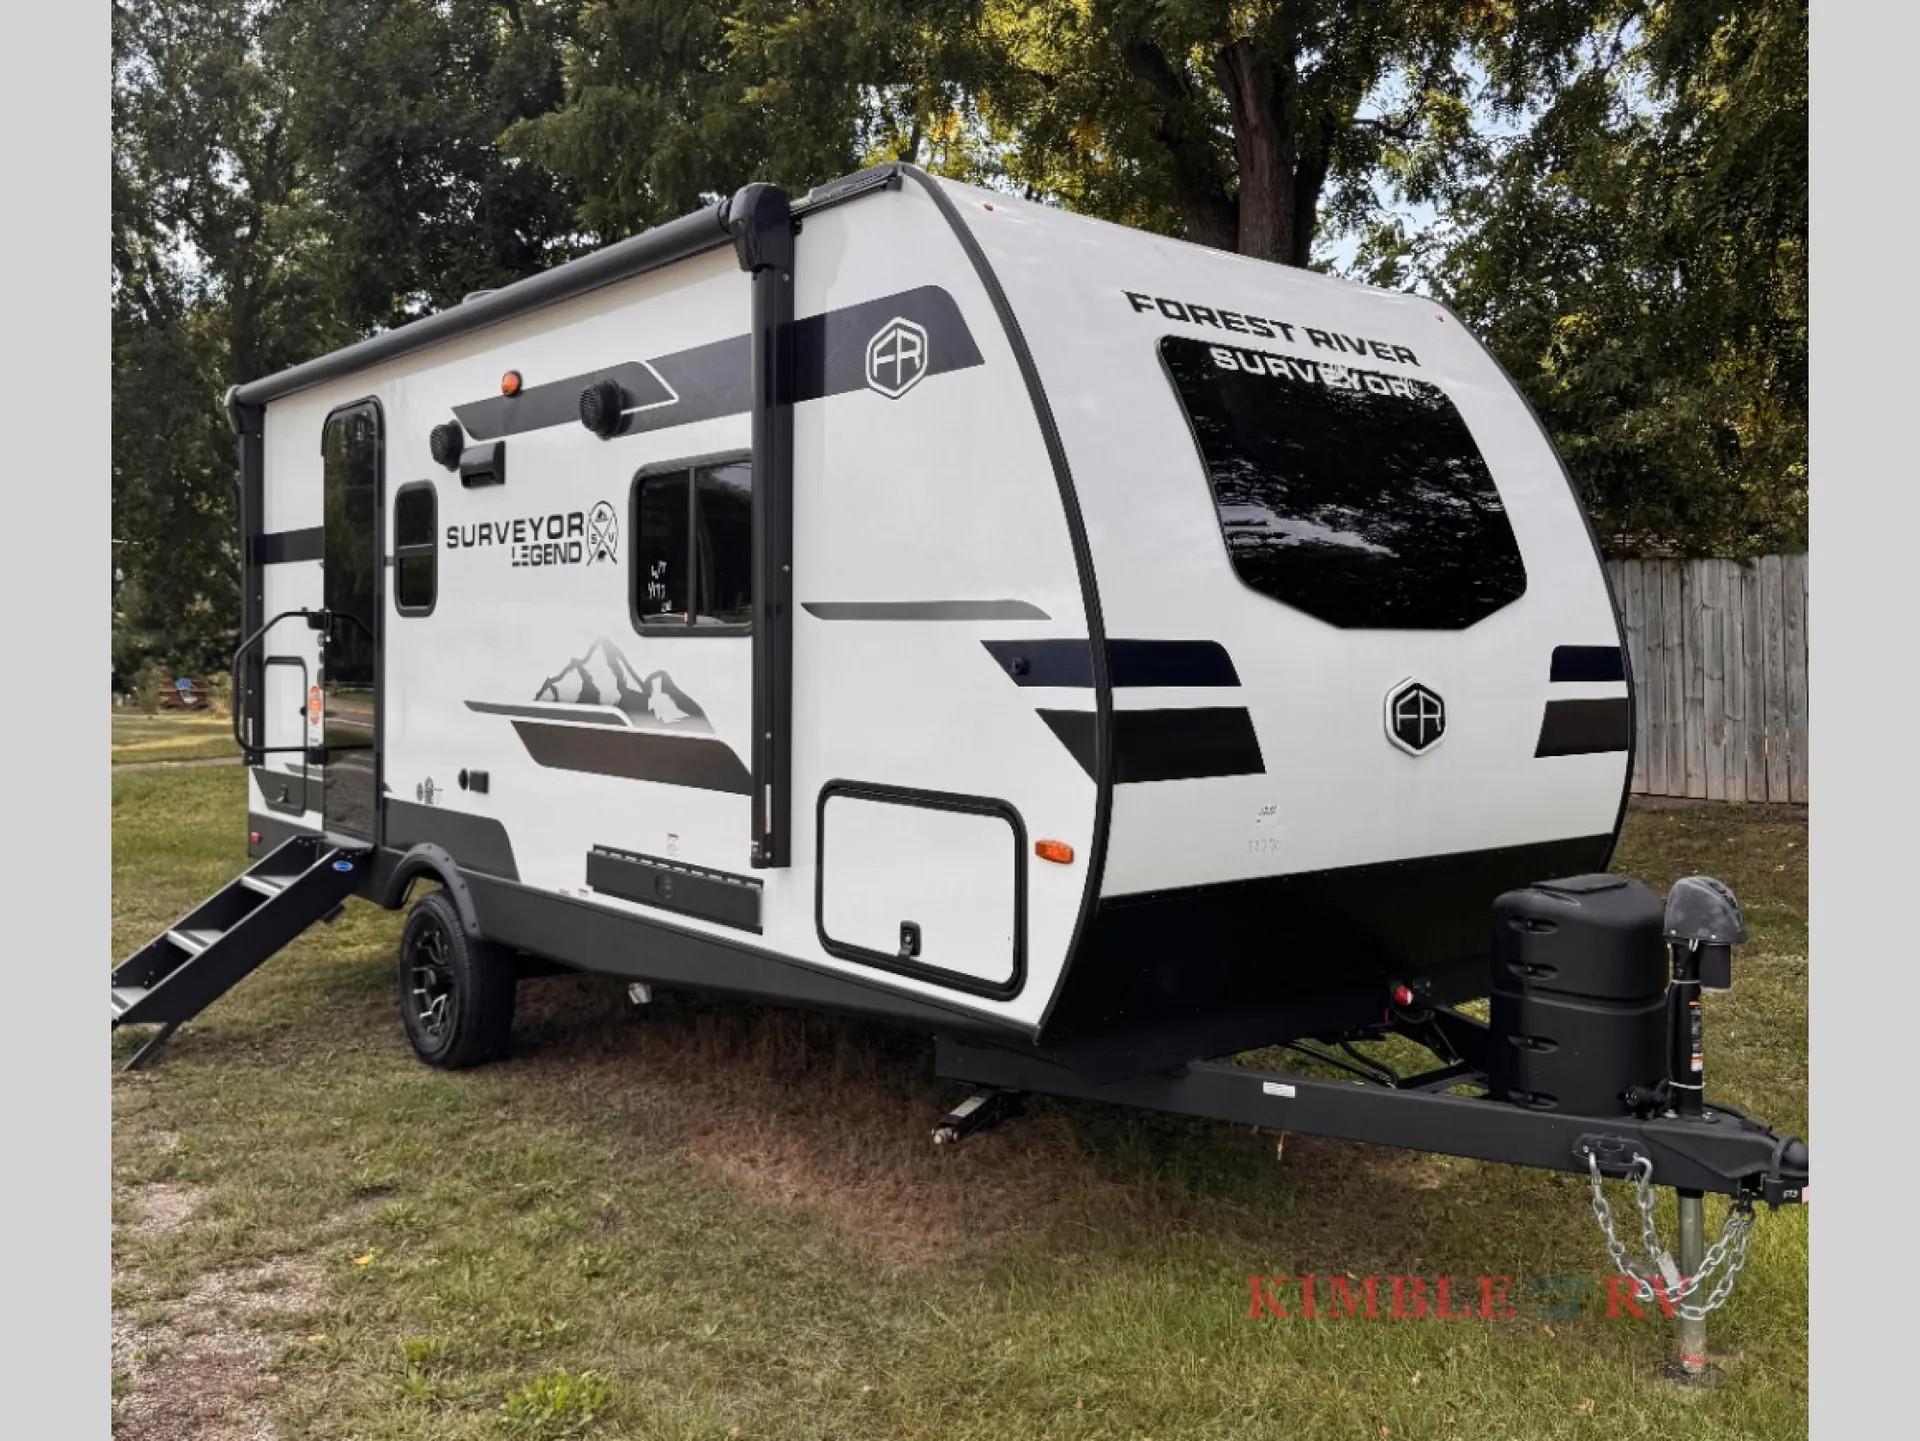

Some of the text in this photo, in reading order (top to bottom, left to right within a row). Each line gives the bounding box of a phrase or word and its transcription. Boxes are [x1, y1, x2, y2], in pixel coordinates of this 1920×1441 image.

[1121, 290, 1422, 367] FOREST RIVER
[1209, 347, 1416, 400] SURVEYOR
[446, 511, 585, 549] SURVEYOR
[511, 541, 583, 567] LEGEND
